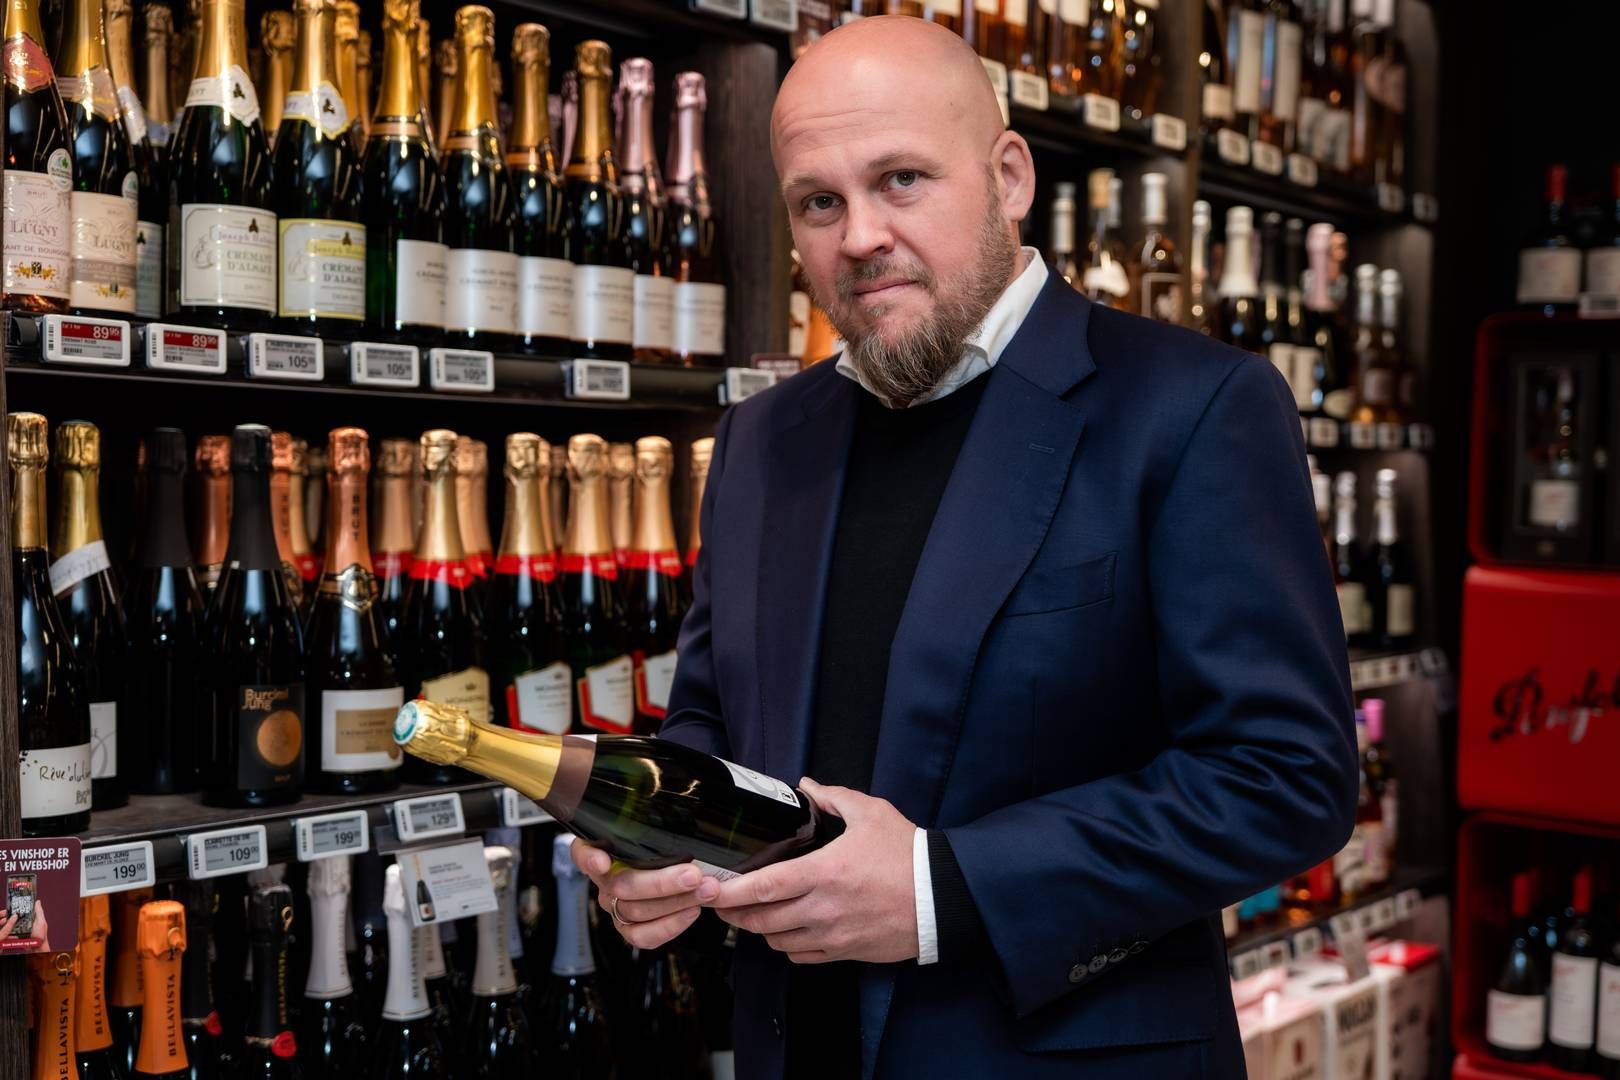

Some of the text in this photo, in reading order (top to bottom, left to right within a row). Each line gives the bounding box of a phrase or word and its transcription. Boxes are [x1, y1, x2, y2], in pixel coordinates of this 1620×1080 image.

[10, 219, 59, 237] LUGNY
[93, 235, 131, 252] LUGNY
[93, 326, 109, 339] 89
[192, 335, 207, 347] 89
[288, 355, 308, 368] 105
[352, 494, 360, 542] BRUT
[241, 699, 273, 712] Jung
[334, 831, 354, 846] 199
[10, 848, 56, 860] VINSHOP
[57, 847, 70, 858] ER
[113, 850, 130, 858] JUNG
[229, 847, 250, 861] 109
[4, 859, 70, 872] EN WEBSHOP
[113, 864, 136, 879] 199
[93, 956, 104, 1036] BELLAVISTA
[167, 973, 177, 1057] BELLAVISTA
